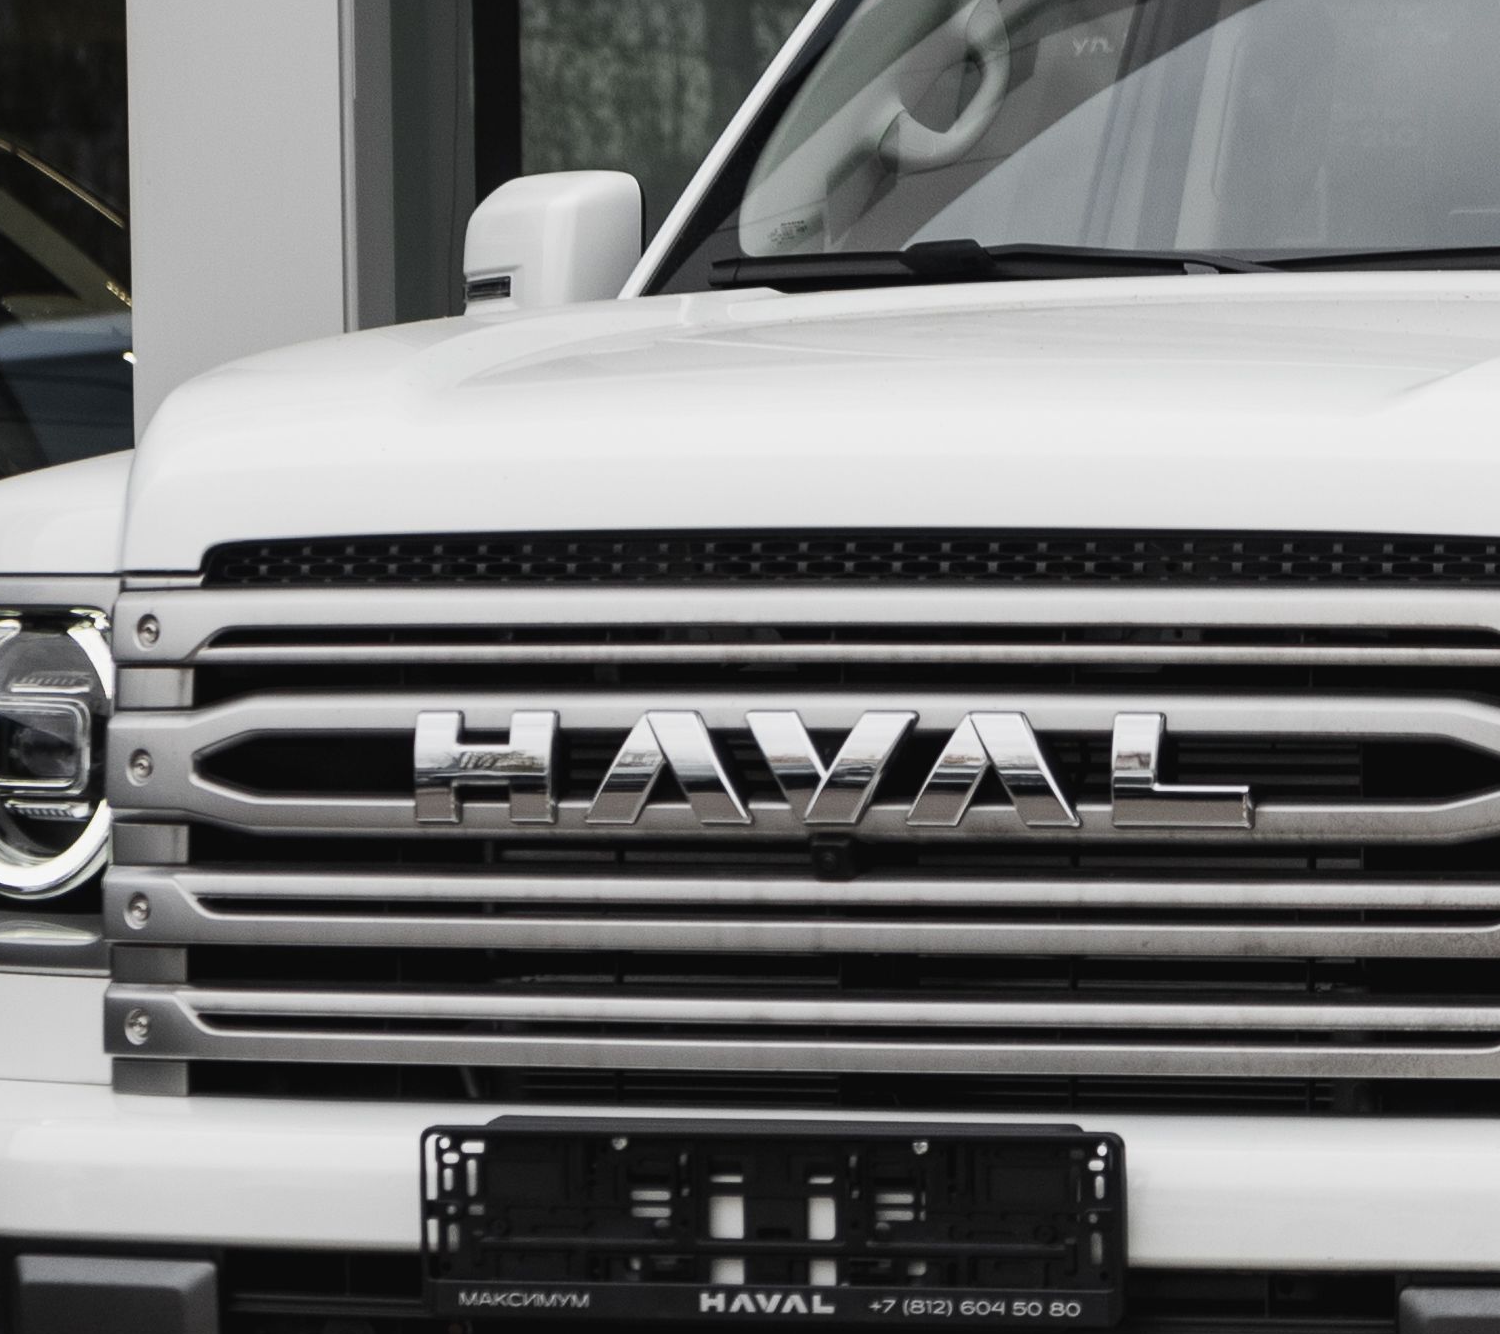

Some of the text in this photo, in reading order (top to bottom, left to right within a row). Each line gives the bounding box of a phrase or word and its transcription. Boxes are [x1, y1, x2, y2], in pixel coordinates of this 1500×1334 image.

[414, 709, 1255, 829] HAVAL
[457, 1291, 590, 1309] МАКСИМУМ
[699, 1292, 836, 1315] HAVAL
[868, 1298, 1082, 1318] +7 (812) 604 50 80
